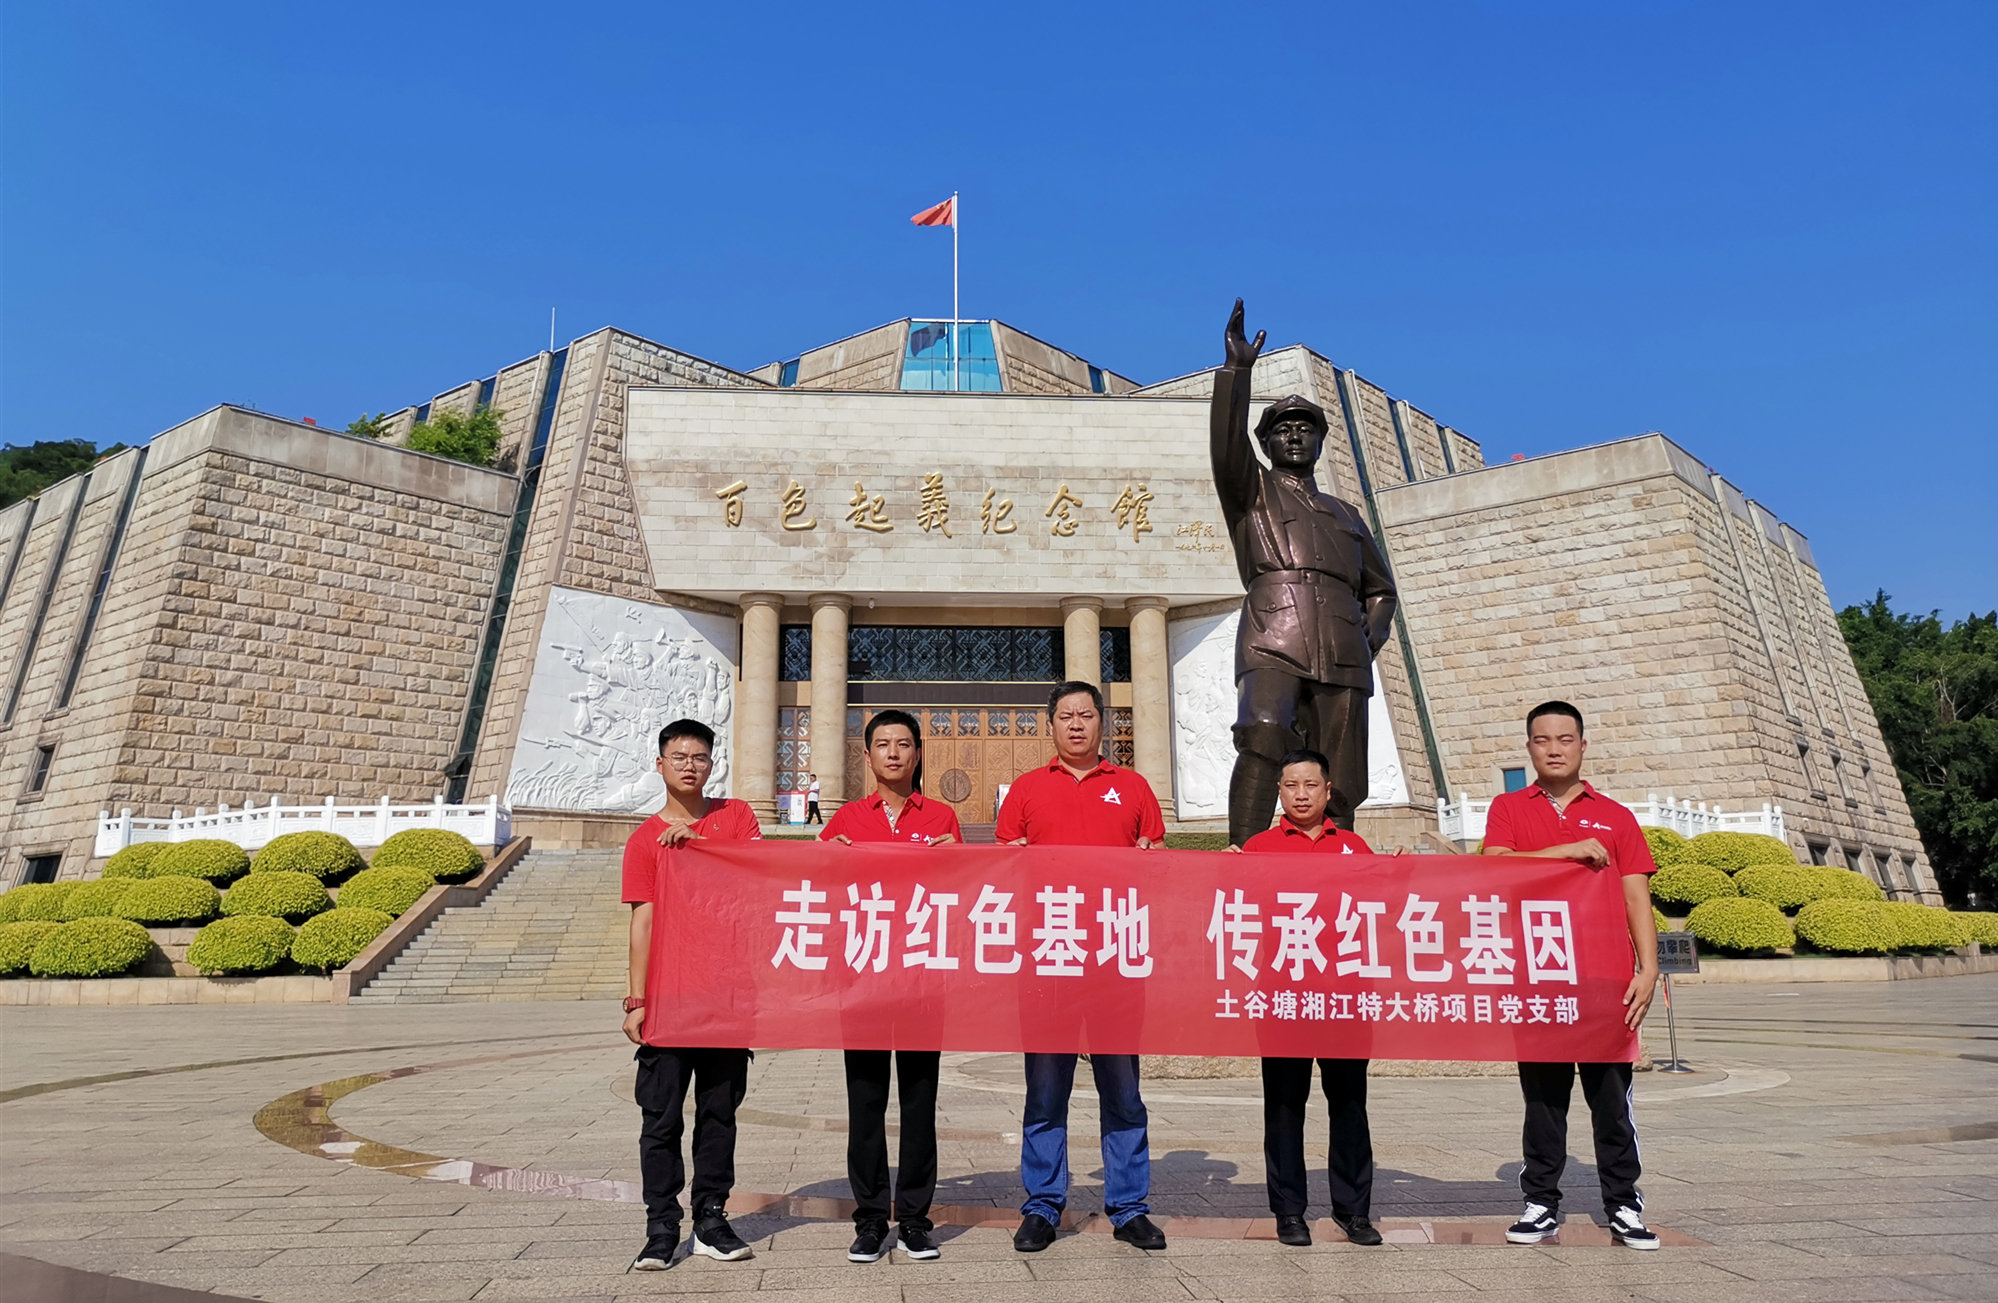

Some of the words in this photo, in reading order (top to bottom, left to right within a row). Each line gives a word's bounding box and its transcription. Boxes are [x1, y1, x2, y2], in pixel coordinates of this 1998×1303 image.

[771, 879, 1154, 978] 走访红色基地
[1206, 888, 1578, 985] 传承红色基因
[1215, 989, 1579, 1025] 土谷塘湘江特大桥项目党支部
